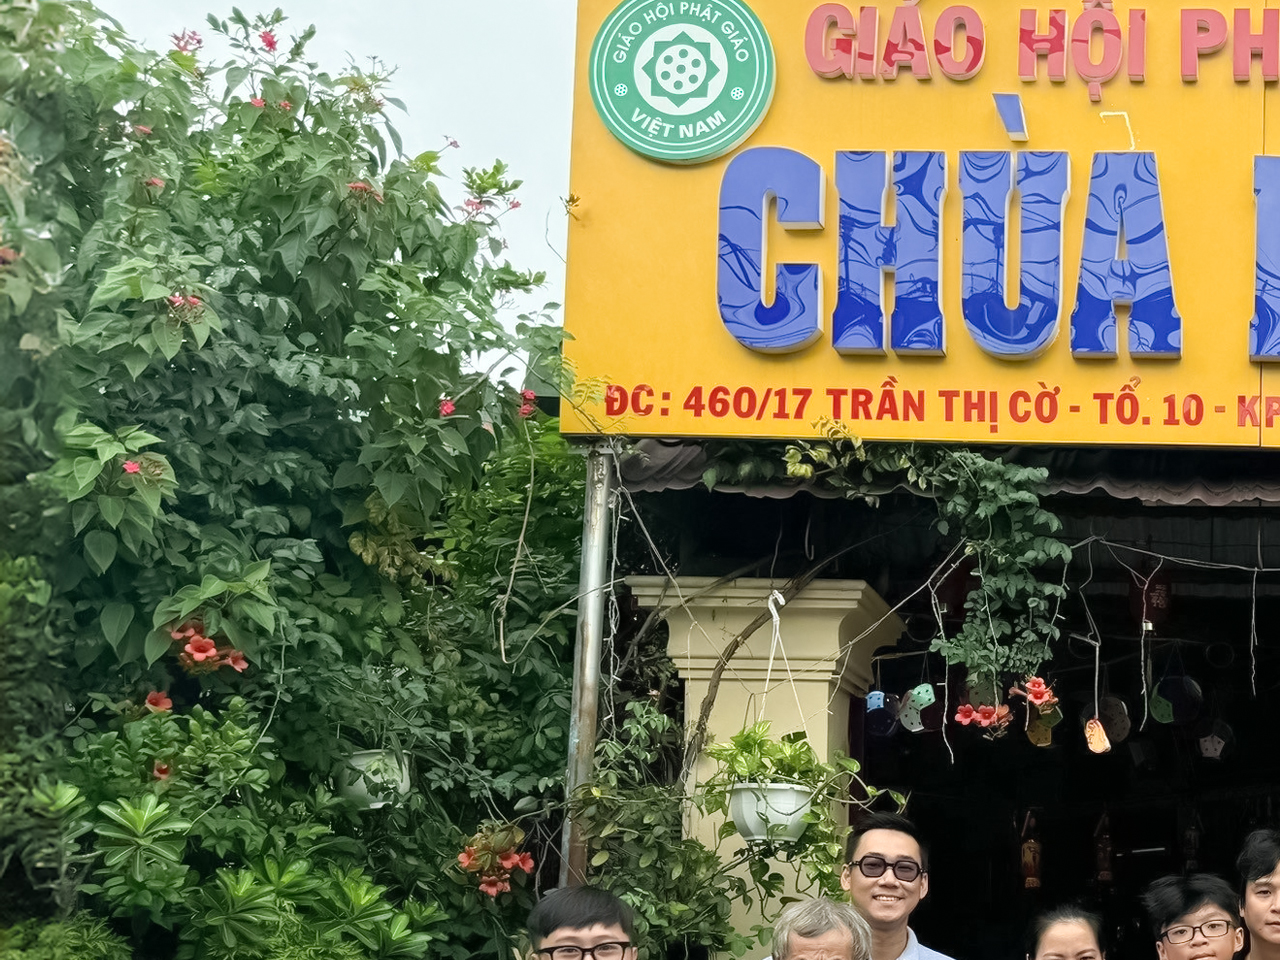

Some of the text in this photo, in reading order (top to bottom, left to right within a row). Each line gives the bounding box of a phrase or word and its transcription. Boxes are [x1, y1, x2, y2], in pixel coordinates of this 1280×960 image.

[613, 1, 749, 63] GIÁO HỘI PHẬT GIÁO
[1018, 0, 1147, 101] HỘI
[631, 107, 727, 138] VIỆT NAM
[716, 93, 1182, 361] CHÙA
[604, 384, 670, 417] ĐC:
[683, 386, 814, 420] 460/17
[826, 376, 925, 422] TRẦN
[938, 389, 999, 433] THỊ
[1009, 381, 1061, 424] CỜ
[1093, 376, 1151, 426] TỔ.
[1163, 392, 1205, 426] 10
